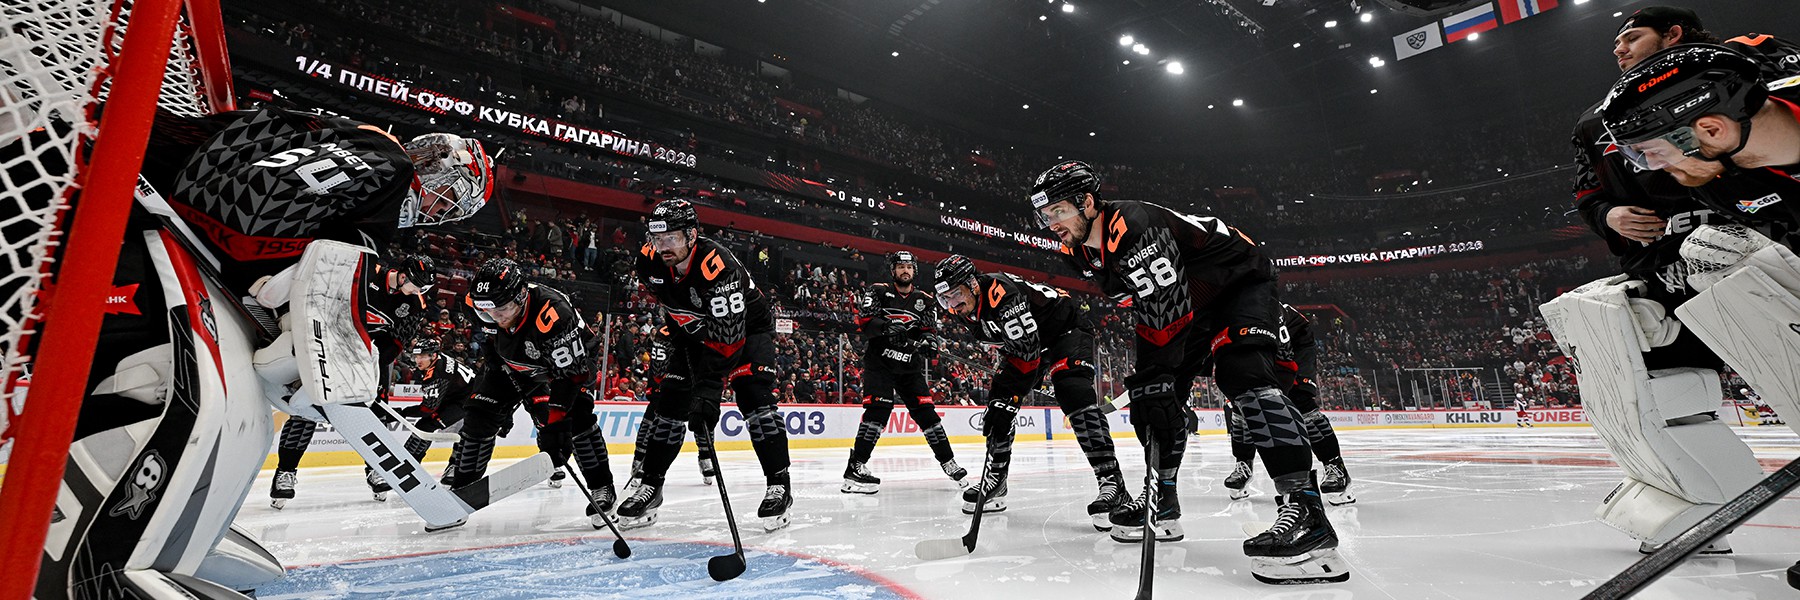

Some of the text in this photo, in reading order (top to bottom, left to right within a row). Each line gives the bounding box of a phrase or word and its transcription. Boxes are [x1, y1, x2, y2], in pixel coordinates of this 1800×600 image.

[295, 55, 697, 169] 1/4 ПЛЕЙ-ОФФ КУБКА ГАГАРИНА 2026
[1673, 92, 1711, 114] CCM
[1756, 194, 1780, 207] сбп
[940, 214, 982, 233] КАЖДЫЙ
[983, 225, 1006, 239] ДЕНЬ
[1014, 232, 1030, 244] КАК
[1276, 240, 1484, 268] ПЛЕЙ-ОФФ КУБКА ГАГАРИНА 2026
[476, 281, 490, 293] 84
[1128, 256, 1178, 299] 58
[710, 292, 746, 318] 88
[1004, 311, 1038, 340] 65
[312, 318, 332, 401] TRUE
[550, 338, 586, 369] 84
[881, 348, 913, 363] FONBET
[1131, 382, 1175, 400] CCM
[1446, 412, 1502, 423] KHL.RU
[1147, 466, 1160, 535] CCM
